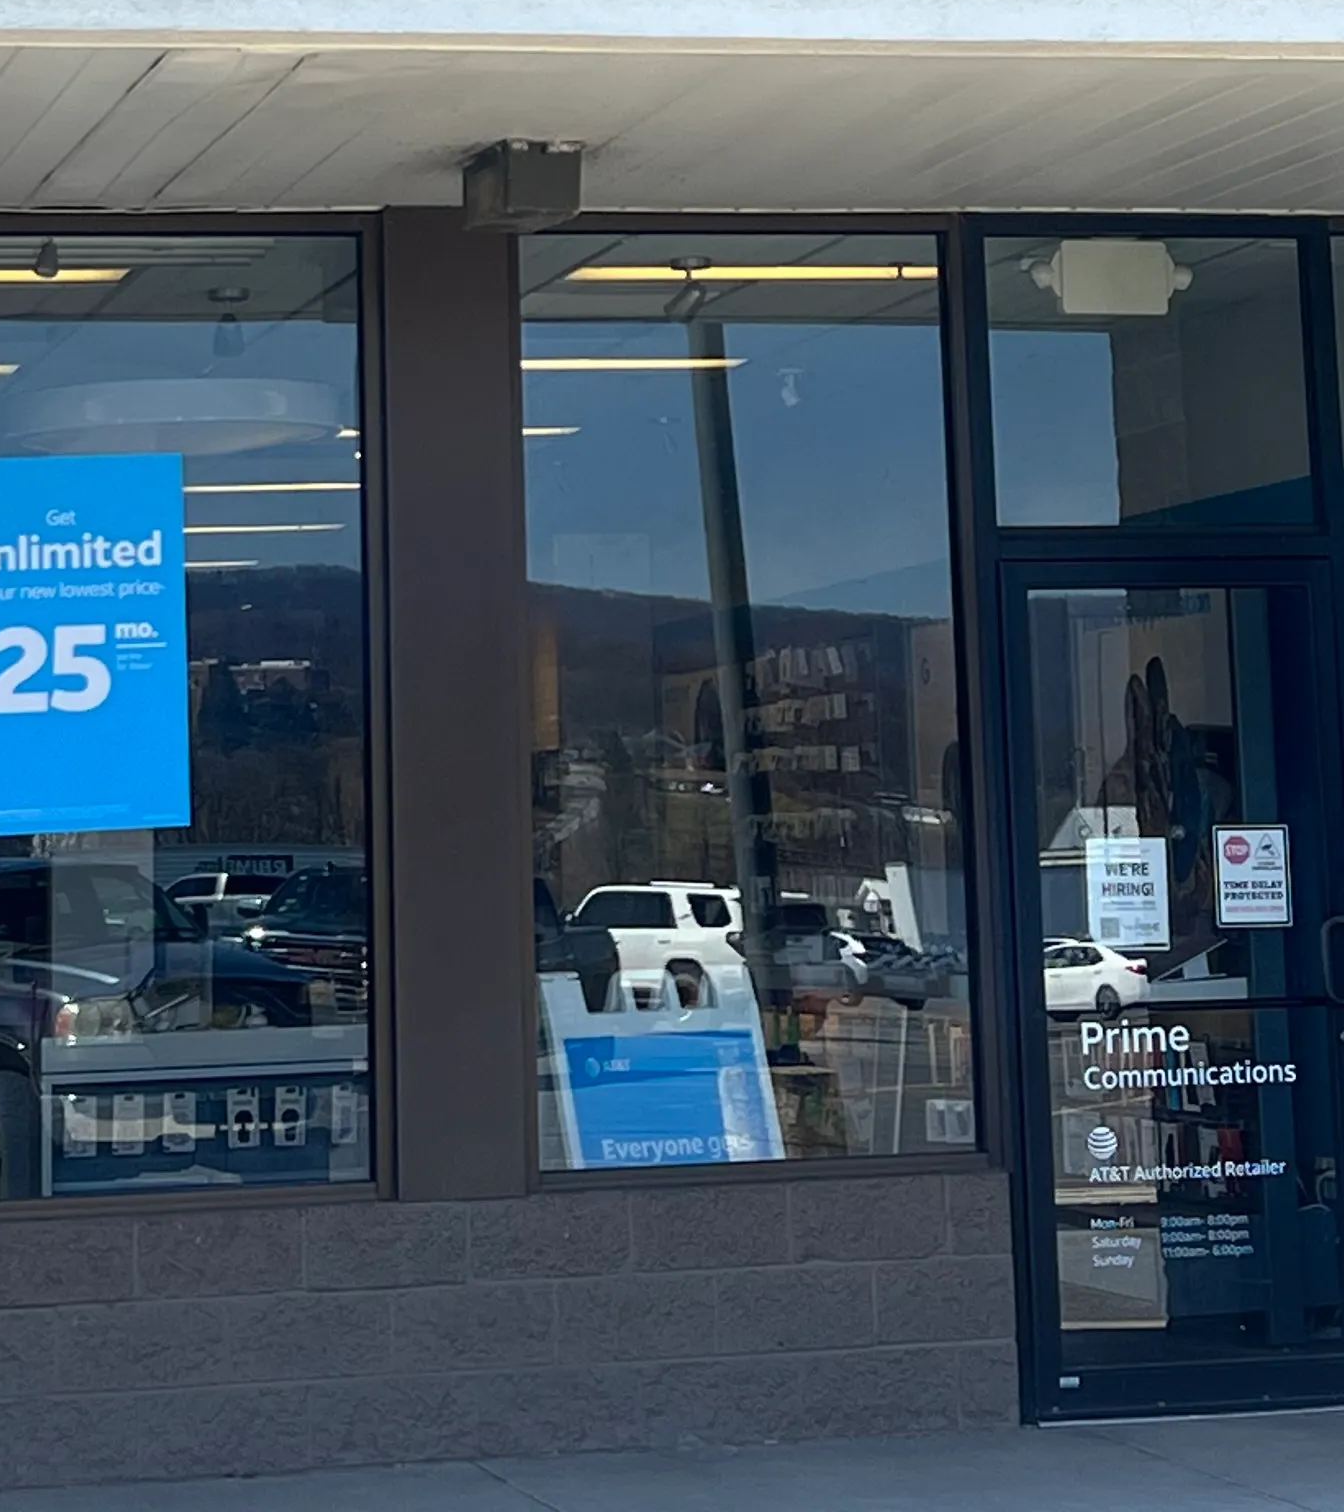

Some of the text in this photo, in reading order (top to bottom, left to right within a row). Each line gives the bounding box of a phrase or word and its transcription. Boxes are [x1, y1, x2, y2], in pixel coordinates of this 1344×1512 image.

[46, 508, 76, 527] Get
[19, 585, 57, 599] new
[59, 581, 115, 598] lowest
[114, 621, 159, 639] mo.
[1104, 862, 1150, 877] WE'RE
[1101, 882, 1155, 897] HIRING!
[1251, 880, 1283, 889] DELAY
[1223, 891, 1284, 900] PROTECTED
[1081, 1019, 1190, 1055] Prime
[1083, 1059, 1297, 1090] Communications
[601, 1137, 704, 1165] Everyone
[1089, 1159, 1286, 1183] AT&T Authorized Retailer
[1090, 1216, 1134, 1230] Mon-Fri
[1091, 1235, 1142, 1250] Saturday
[1092, 1254, 1135, 1269] Sunday
